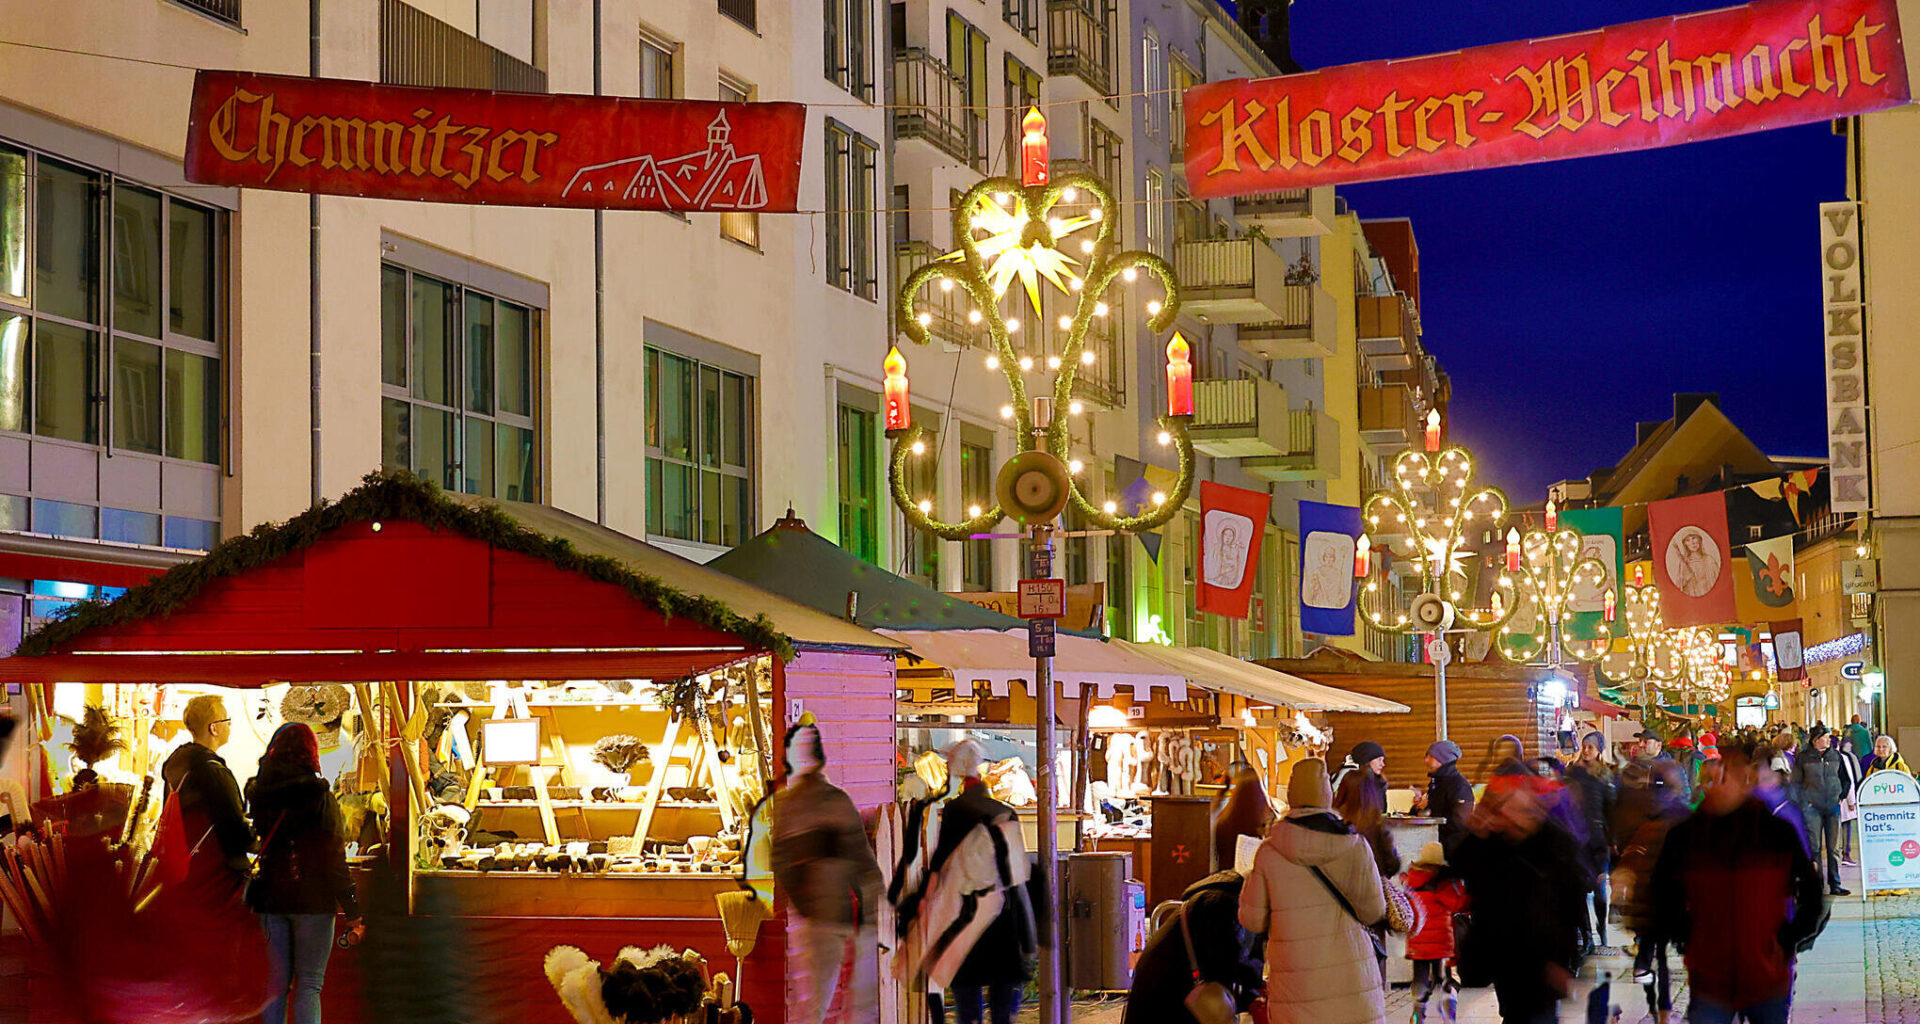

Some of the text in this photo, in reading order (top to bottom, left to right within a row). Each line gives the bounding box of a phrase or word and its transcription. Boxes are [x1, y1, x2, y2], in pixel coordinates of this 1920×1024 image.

[1199, 14, 1886, 178] Kloster-Weihnacht
[208, 86, 559, 190] Chemnitzer
[1823, 208, 1867, 501] VOLKSBANK
[1132, 708, 1141, 716] 19
[1863, 810, 1916, 822] Chemnitz
[1864, 823, 1895, 832] hat's.
